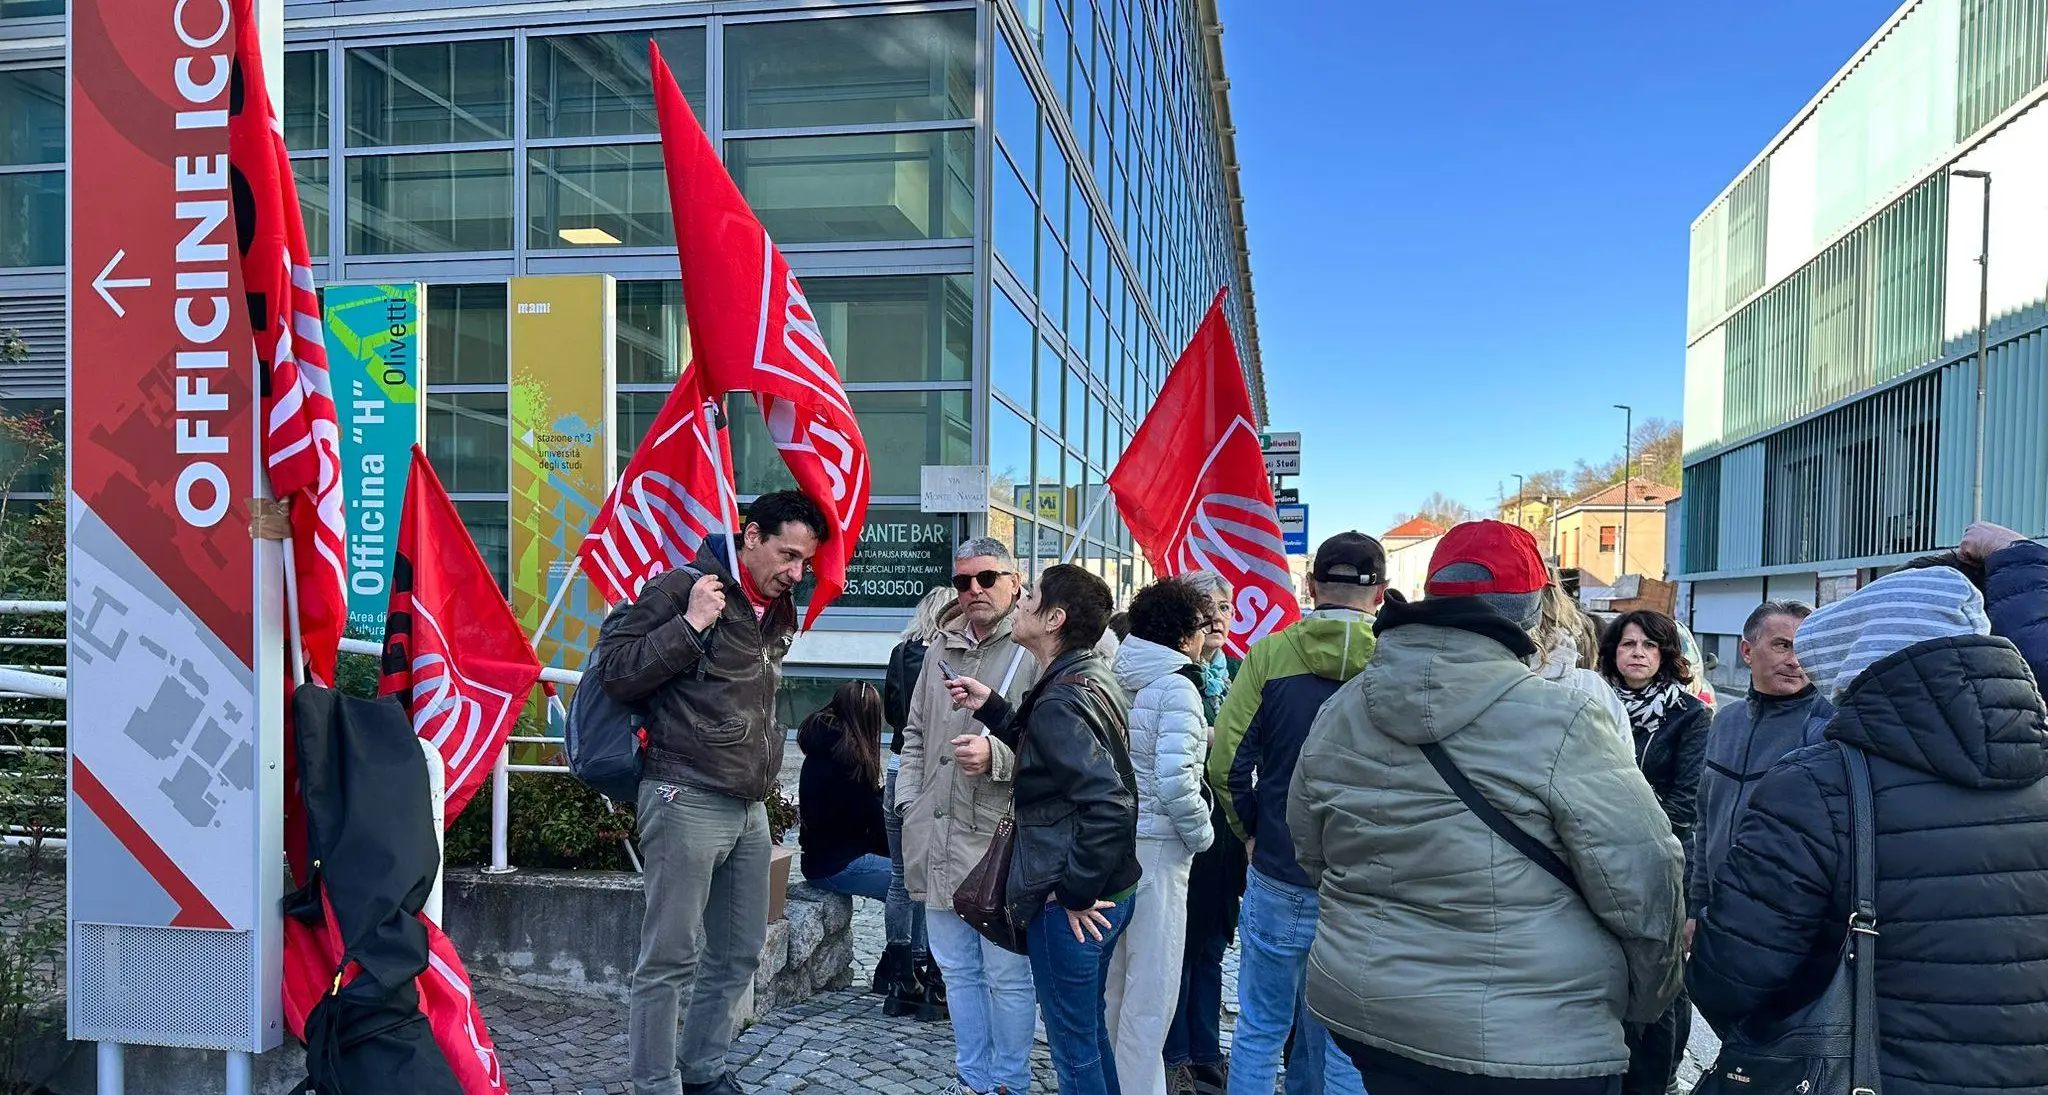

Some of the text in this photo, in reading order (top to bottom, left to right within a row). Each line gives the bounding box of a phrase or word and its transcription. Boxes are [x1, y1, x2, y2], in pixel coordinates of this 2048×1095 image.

[174, 154, 230, 528] OFFICINE
[383, 298, 407, 386] Olivetti
[537, 432, 573, 443] stazione
[586, 433, 592, 443] 3
[538, 448, 581, 458] università
[538, 459, 583, 471] degli studi
[1276, 459, 1297, 468] Studi
[351, 454, 385, 596] Officina
[911, 523, 944, 543] BAR
[864, 550, 877, 558] TUA
[878, 550, 899, 559] PAUSA
[866, 564, 894, 573] SPECIALI
[895, 564, 906, 573] PER
[907, 564, 924, 573] TAKE
[925, 564, 943, 573] AWAY
[349, 611, 374, 623] Area
[350, 624, 386, 636] ultura
